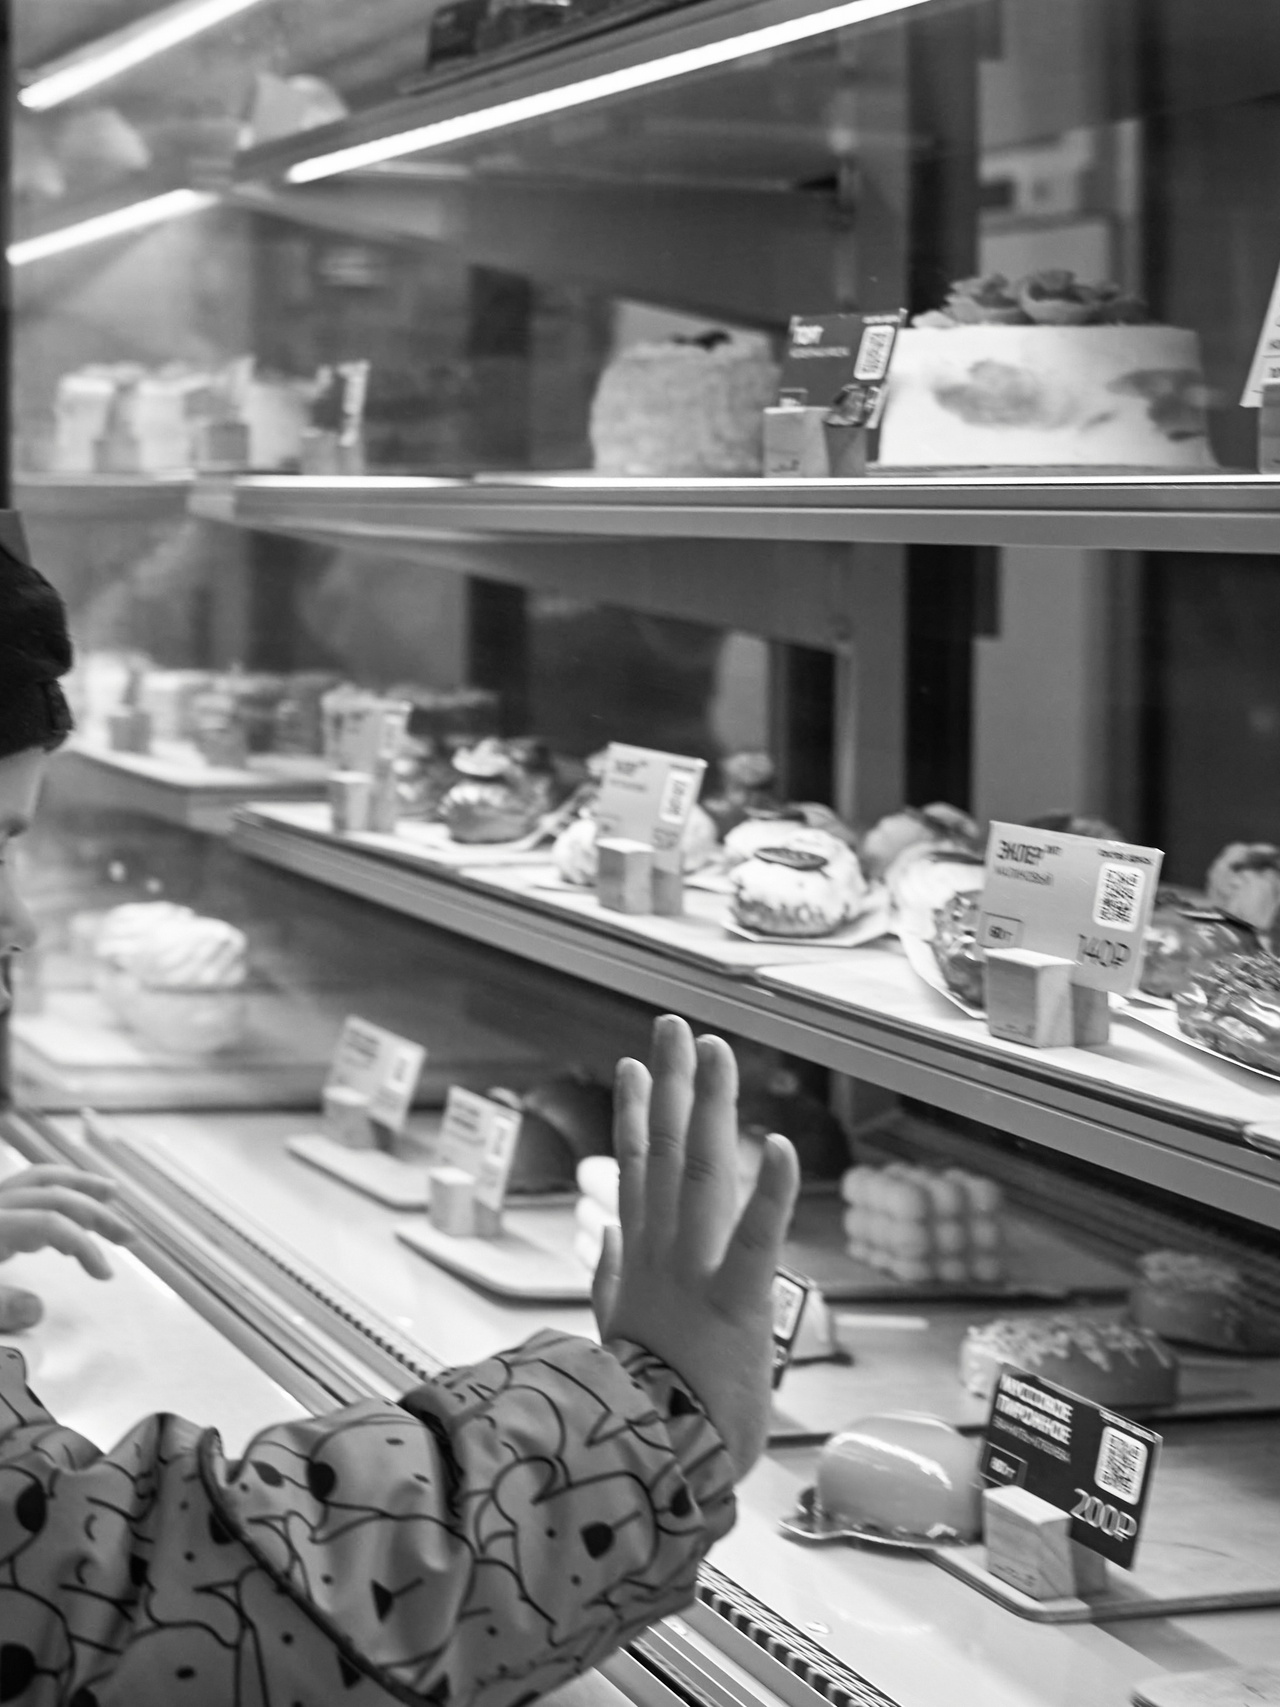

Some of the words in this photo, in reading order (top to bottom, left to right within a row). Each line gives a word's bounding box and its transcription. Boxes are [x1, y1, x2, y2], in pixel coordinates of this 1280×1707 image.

[997, 840, 1044, 865] ЭКЛЕР
[995, 1392, 1073, 1446] ПИРОЖНОЕ
[1069, 1487, 1138, 1543] 200₽
